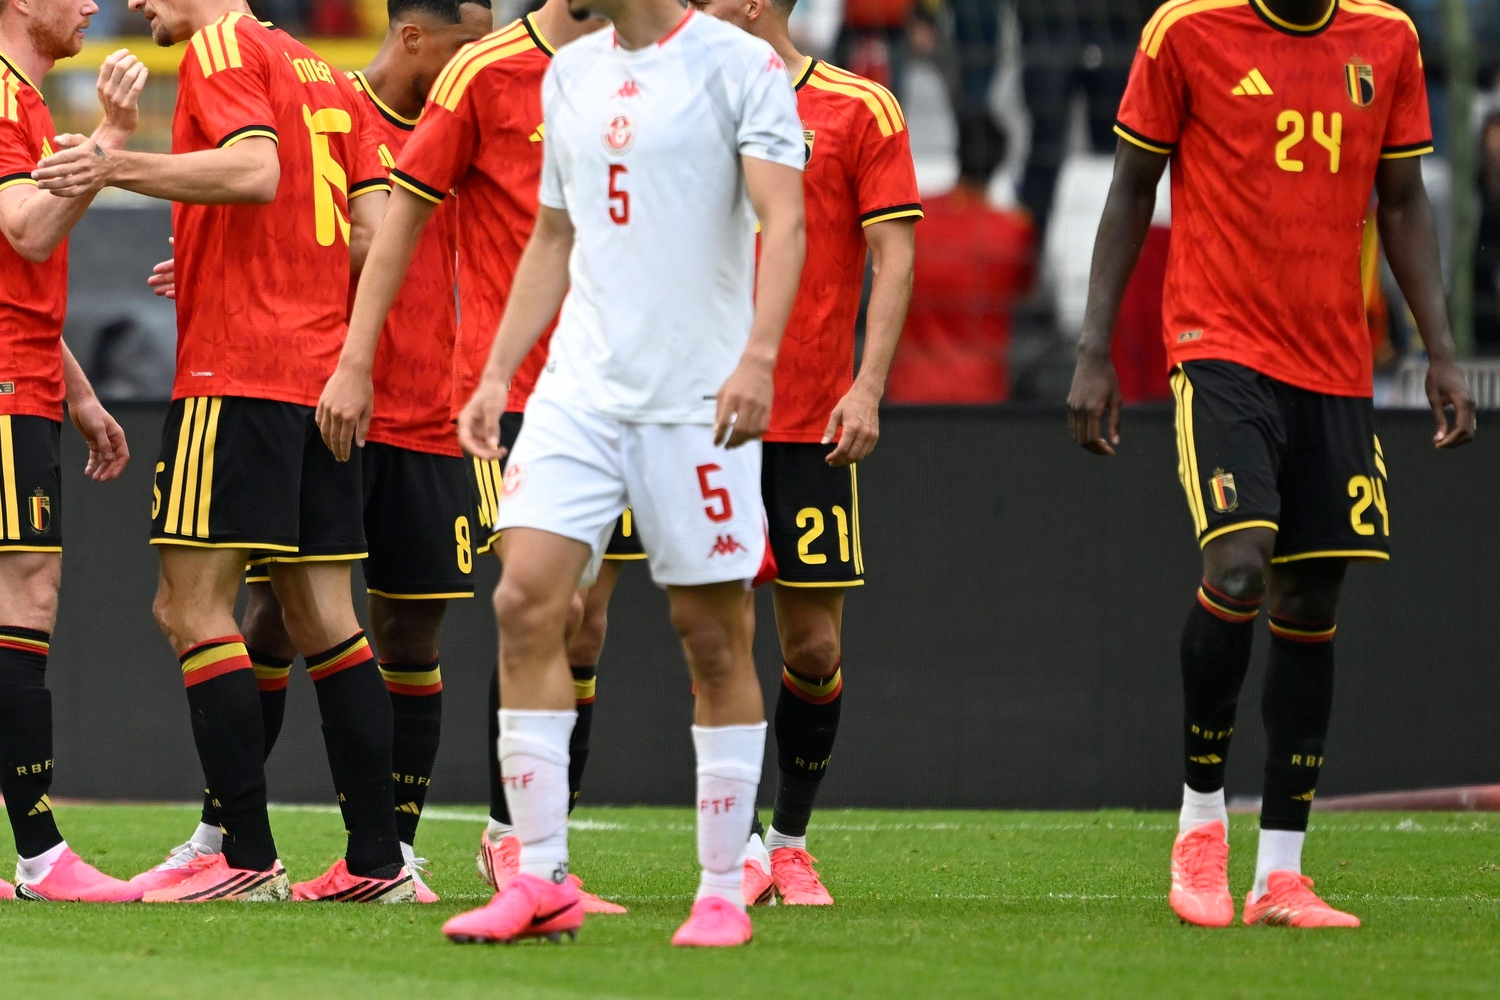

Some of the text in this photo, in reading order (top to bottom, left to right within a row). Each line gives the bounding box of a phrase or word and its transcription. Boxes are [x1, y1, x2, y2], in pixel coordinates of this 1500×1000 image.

[1275, 109, 1343, 174] 24
[608, 163, 629, 225] 5
[696, 463, 733, 524] 5
[1348, 474, 1390, 537] 24
[454, 515, 473, 574] 8
[796, 505, 850, 565] 21
[16, 758, 55, 776] RBF
[795, 754, 832, 770] RBF
